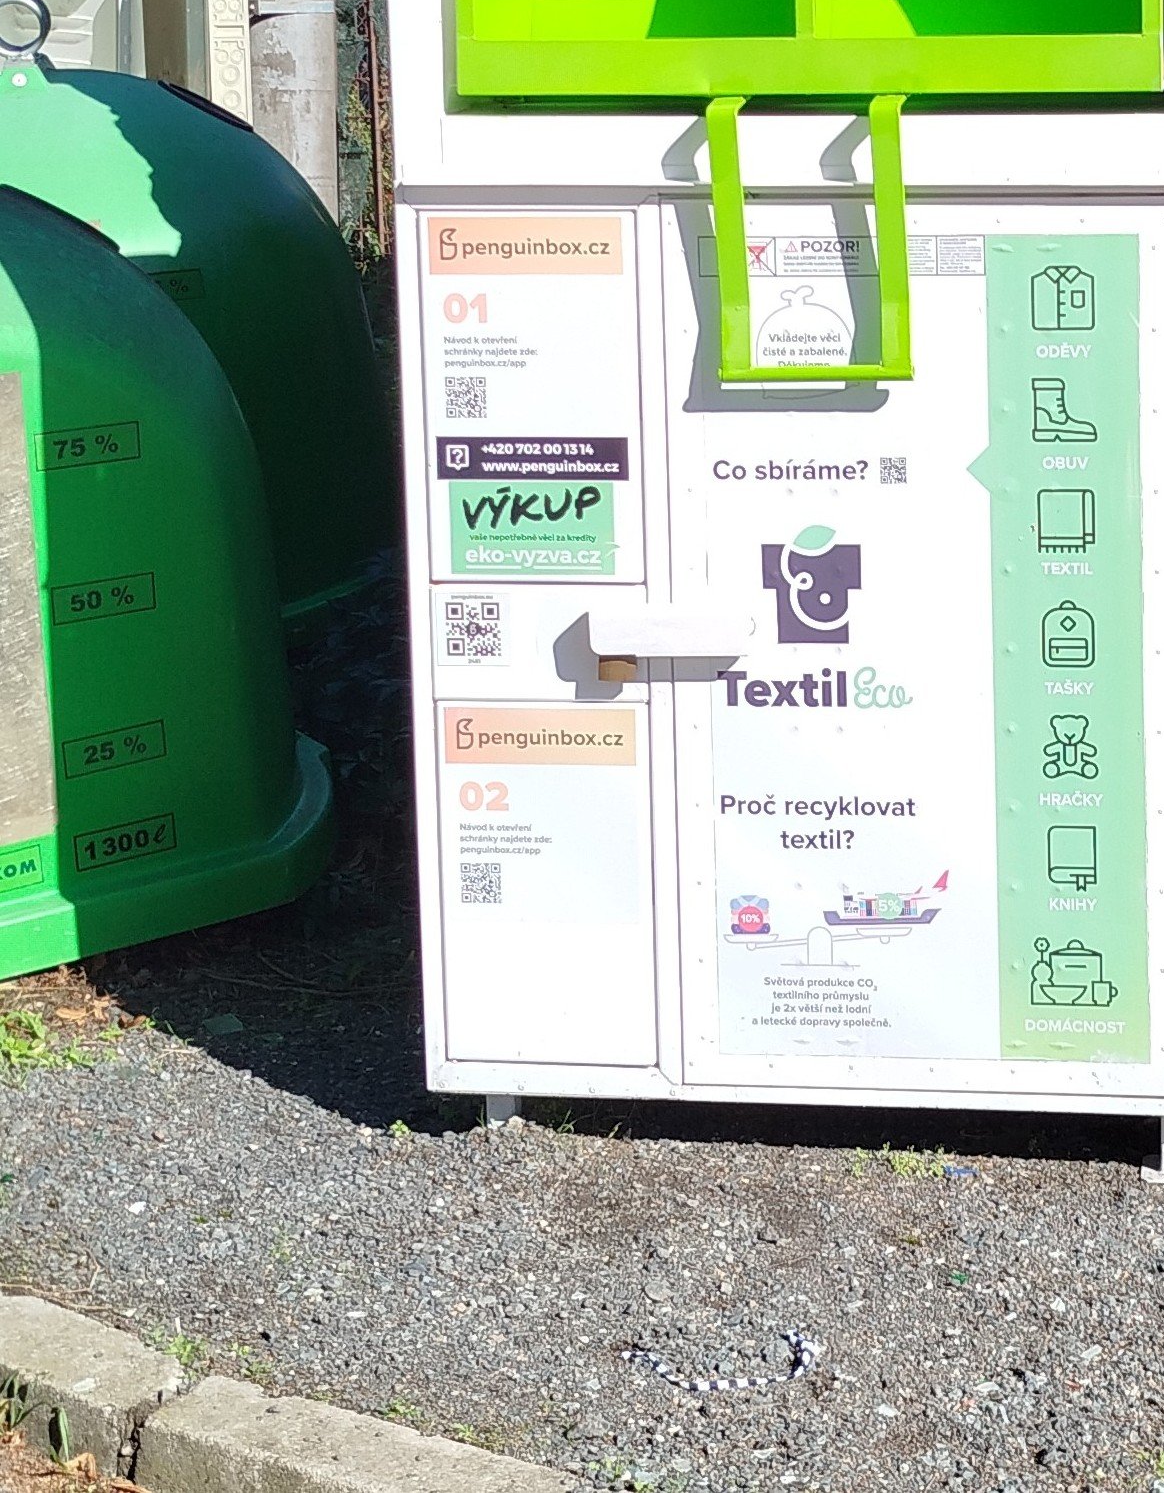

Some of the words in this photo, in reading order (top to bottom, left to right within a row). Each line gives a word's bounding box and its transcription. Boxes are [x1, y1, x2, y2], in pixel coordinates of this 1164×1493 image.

[462, 238, 610, 259] penguinbox.cz
[801, 240, 860, 253] POZOR!
[443, 293, 488, 323] 01
[444, 336, 472, 344] Návod
[474, 336, 479, 344] k
[768, 332, 818, 344] Vkládejte
[820, 332, 841, 342] věci
[444, 348, 483, 357] schránky
[485, 348, 518, 357] najdete
[519, 348, 538, 356] zde:
[762, 347, 787, 356] čisté
[798, 347, 847, 356] zabalené.
[1036, 343, 1092, 359] ODĚVY
[444, 359, 527, 368] penguinbox.cz/app
[53, 437, 87, 460] 75
[95, 433, 119, 454] %
[481, 443, 513, 455] +420
[515, 443, 541, 455] 702
[543, 443, 562, 455] 00
[579, 443, 595, 456] 14
[481, 459, 620, 474] www.penguinbox.cz
[712, 459, 747, 480] Co
[755, 458, 869, 481] sbíráme?
[1042, 456, 1089, 470] OBUV
[462, 486, 601, 530] VÝKUP
[566, 534, 597, 543] kredity
[465, 545, 602, 567] eko-vyzva.cz
[1041, 561, 1093, 576] TEXTIL
[70, 589, 102, 613] 50
[111, 585, 135, 607] %
[717, 667, 848, 708] Textil
[1044, 679, 1094, 696] TAŠKY
[478, 729, 624, 749] penguinbox.cz
[83, 739, 115, 765] 25
[123, 734, 147, 756] %
[459, 781, 509, 811] 02
[1039, 790, 1103, 807] HRAČKY
[720, 793, 777, 815] Proč
[784, 796, 916, 821] recyklovat
[459, 823, 487, 831] Návod
[489, 823, 494, 831] k
[459, 834, 498, 844] schránky
[500, 835, 532, 844] najdete
[534, 835, 552, 843] zde:
[780, 829, 855, 850] textil?
[460, 846, 541, 855] penguinbox.cz/app
[0, 859, 37, 880] OM
[878, 899, 900, 912] 5%
[1048, 897, 1097, 912] KNIHY
[740, 913, 761, 924] 10%
[763, 976, 804, 987] Světová
[807, 977, 855, 988] produkce
[772, 990, 820, 1000] textilního
[822, 990, 869, 1002] průmyslu
[771, 1002, 781, 1014] je
[783, 1003, 797, 1013] 2x
[798, 1003, 823, 1013] větší
[825, 1004, 843, 1014] než
[845, 1004, 872, 1014] lodní
[760, 1016, 797, 1026] letecké
[799, 1016, 841, 1028] dopravy
[843, 1018, 892, 1028] společně.
[1024, 1016, 1125, 1034] DOMÁCNOST
